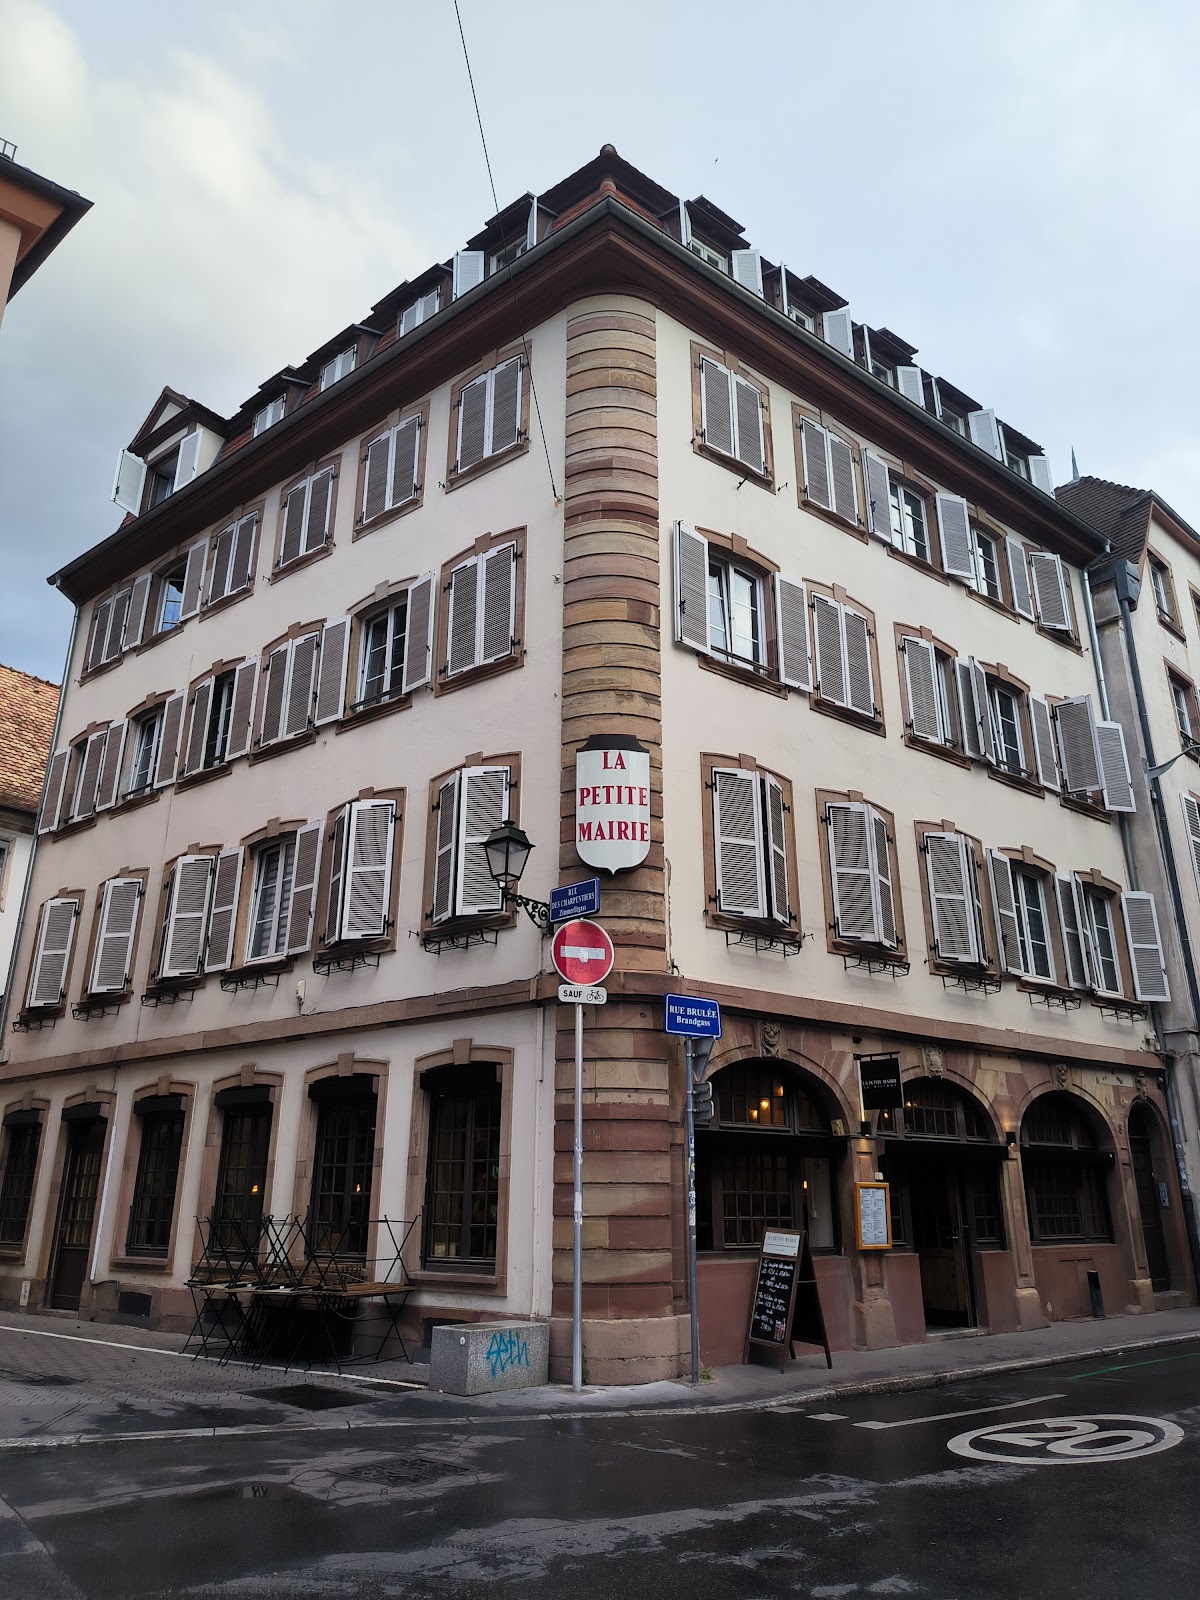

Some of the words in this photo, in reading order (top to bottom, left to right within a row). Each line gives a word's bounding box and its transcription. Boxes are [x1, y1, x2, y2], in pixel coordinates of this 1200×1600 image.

[602, 751, 626, 770] LA
[578, 785, 648, 807] PETITE
[578, 820, 649, 842] MAIRIE
[568, 887, 578, 896] RUE
[551, 901, 561, 909] DES
[561, 892, 595, 907] CHARPENTIERS
[563, 990, 583, 998] SAUF
[669, 1005, 686, 1015] RUE
[676, 1015, 711, 1028] Brandgass
[979, 1420, 1155, 1456] 20
